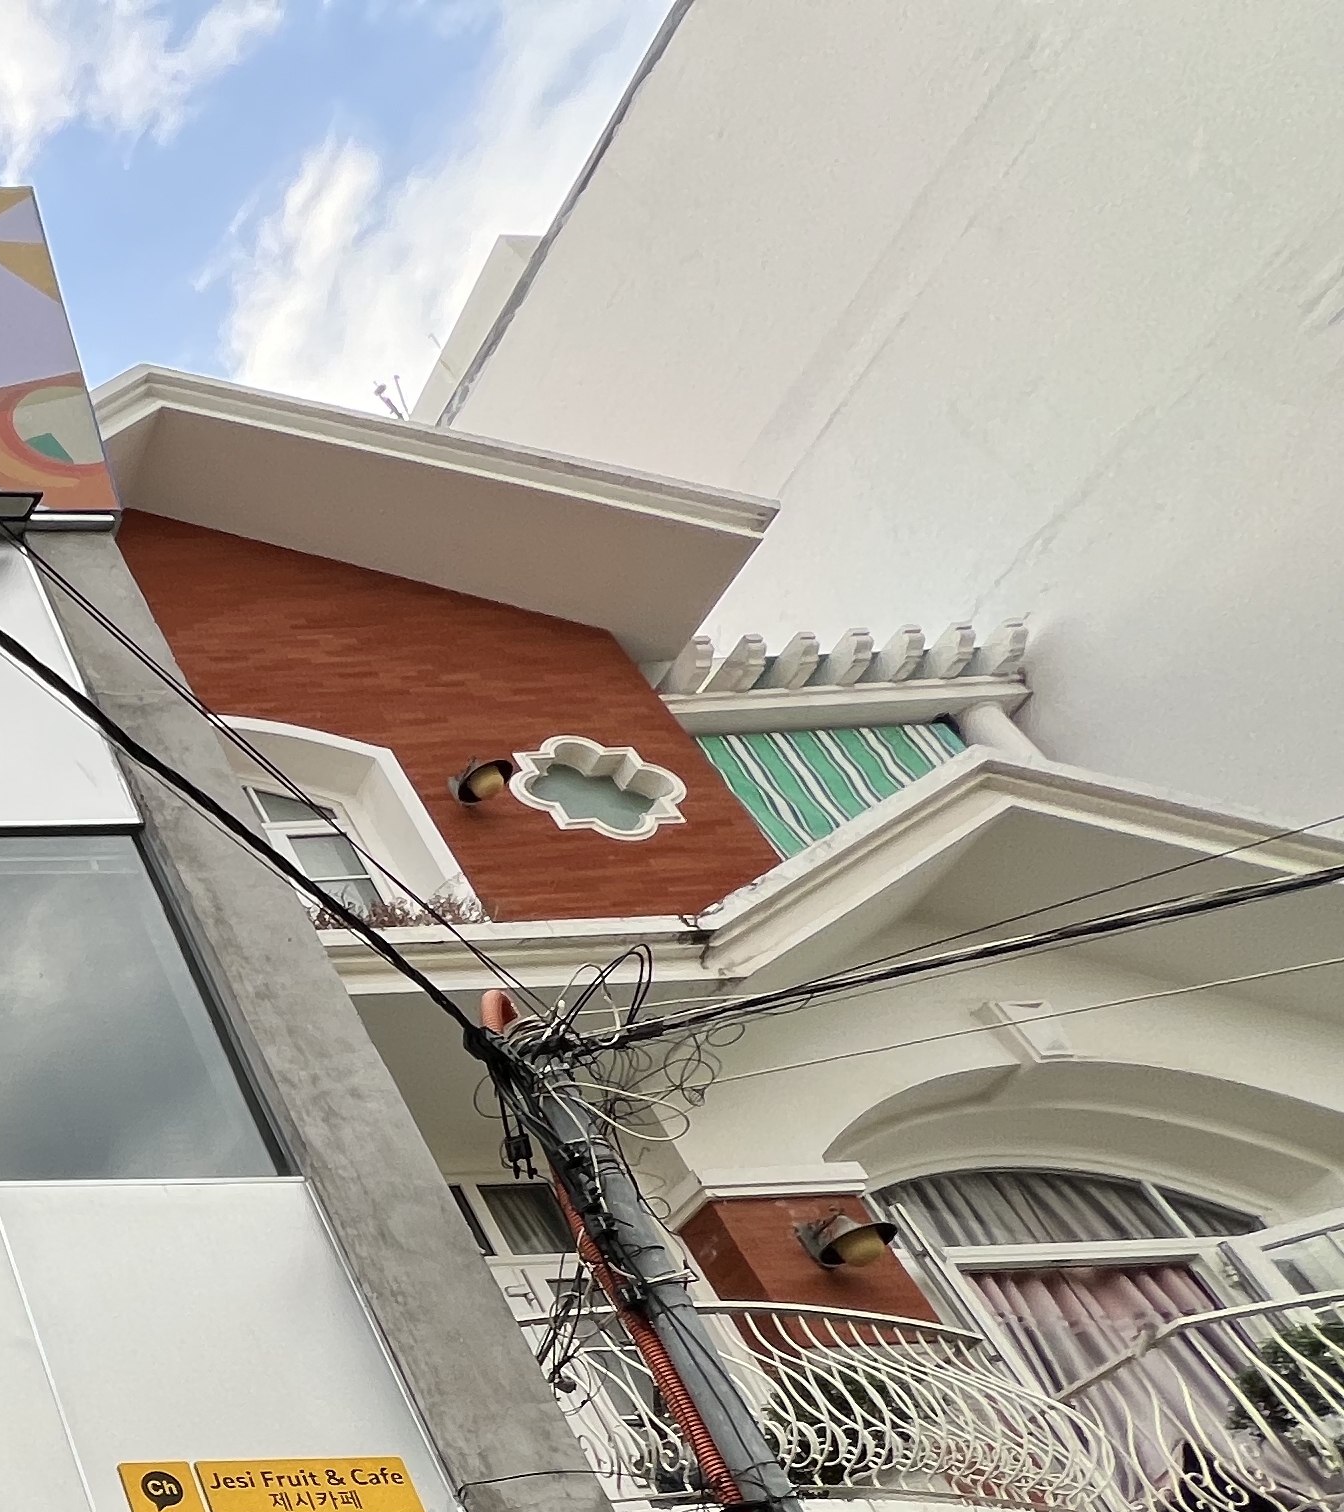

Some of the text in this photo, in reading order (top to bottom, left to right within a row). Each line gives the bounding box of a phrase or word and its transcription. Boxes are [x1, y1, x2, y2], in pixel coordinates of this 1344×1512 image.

[146, 1478, 178, 1497] Ch
[209, 1467, 405, 1490] Jesi Fruit & Cafe
[268, 1490, 363, 1512] 제시카페
